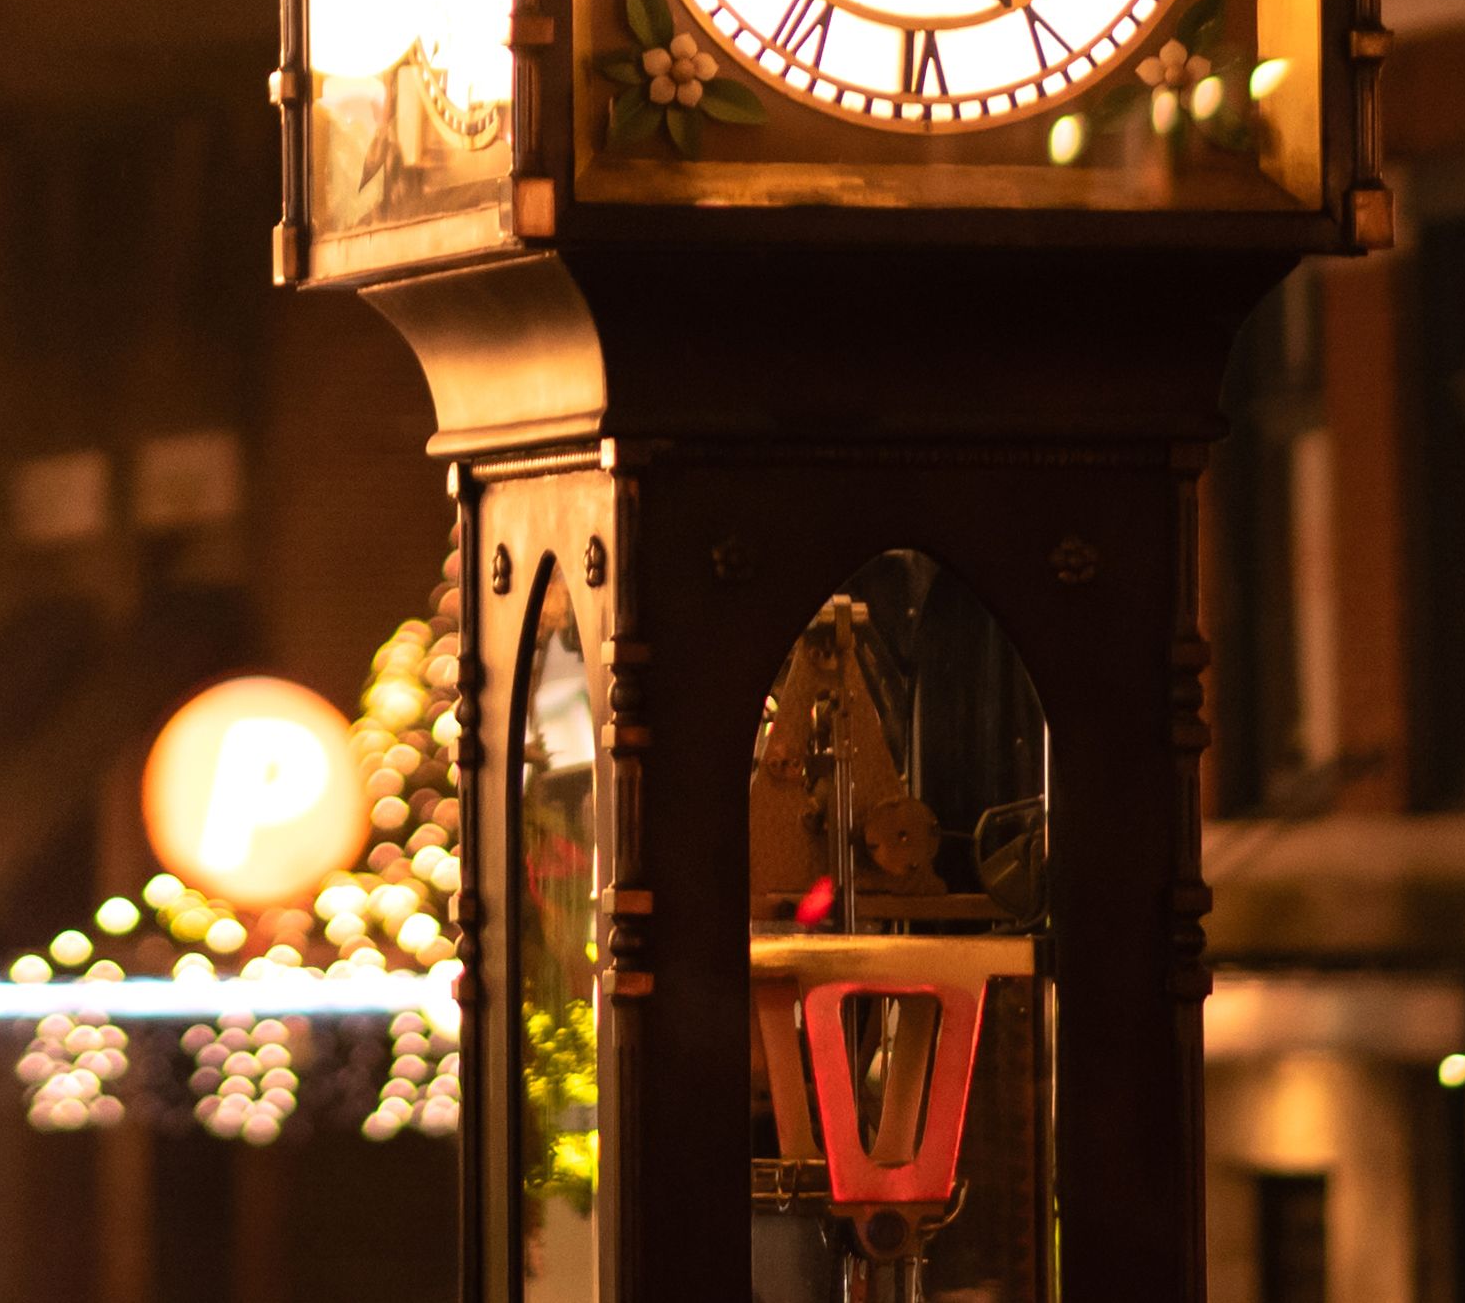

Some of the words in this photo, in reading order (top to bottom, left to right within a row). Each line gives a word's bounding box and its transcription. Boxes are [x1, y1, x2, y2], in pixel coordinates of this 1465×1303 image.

[903, 29, 950, 96] VI
[1023, 3, 1075, 72] V
[198, 719, 329, 873] P
